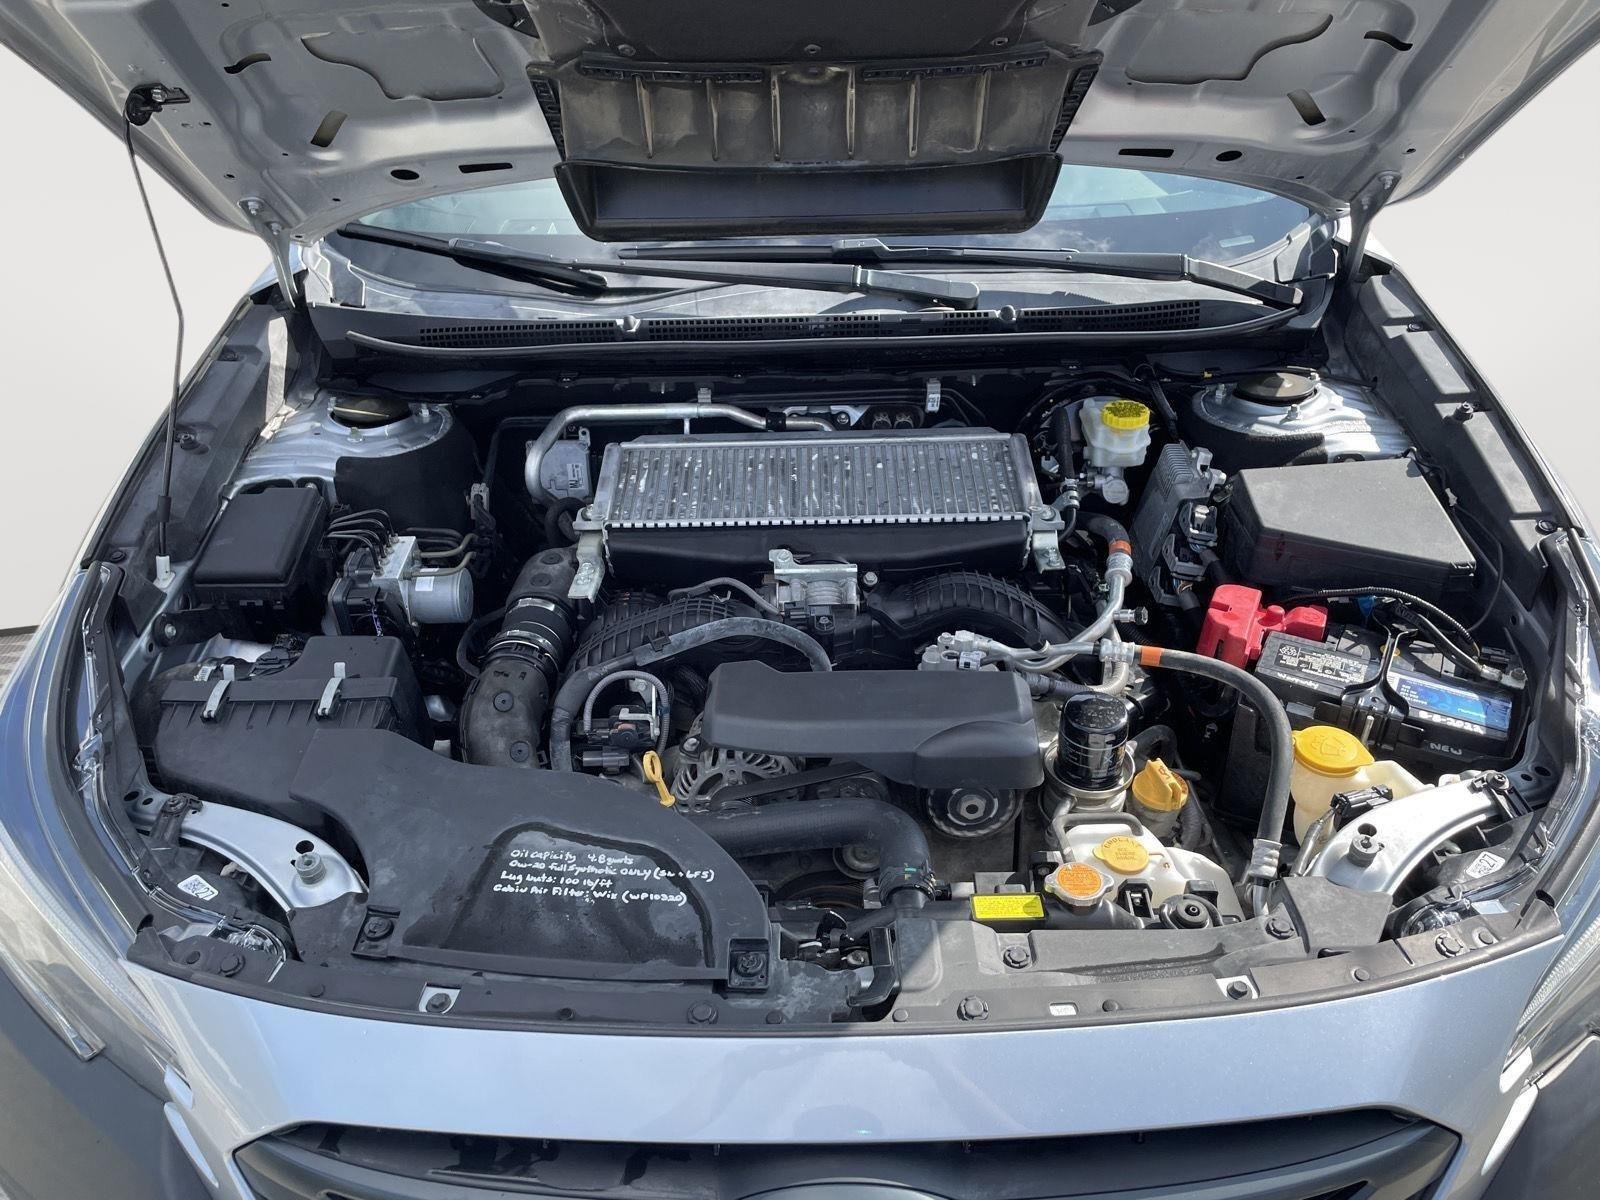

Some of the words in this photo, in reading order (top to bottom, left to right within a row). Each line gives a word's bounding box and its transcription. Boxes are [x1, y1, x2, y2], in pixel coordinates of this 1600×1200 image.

[510, 849, 529, 858] Oil
[500, 870, 523, 885] Lug
[560, 877, 580, 885] 100
[530, 885, 549, 894] Air
